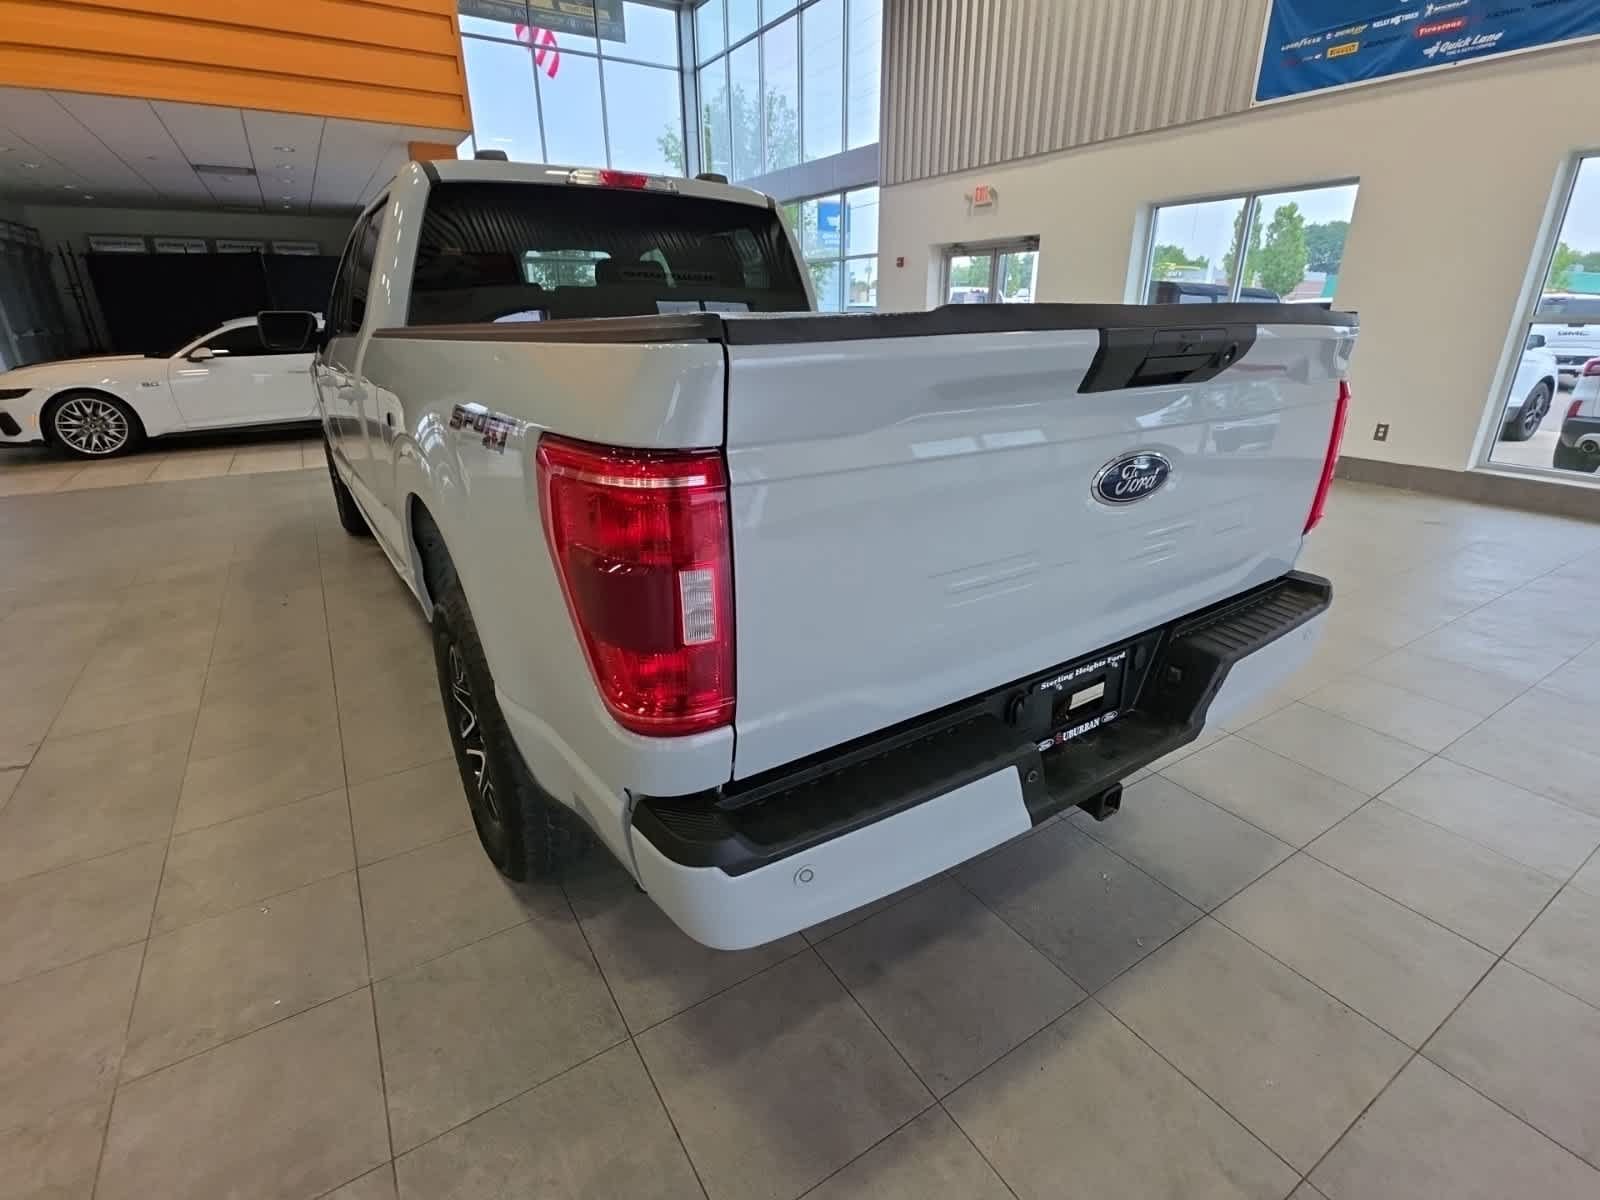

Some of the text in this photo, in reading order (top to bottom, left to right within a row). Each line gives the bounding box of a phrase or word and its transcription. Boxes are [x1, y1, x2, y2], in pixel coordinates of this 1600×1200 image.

[1440, 30, 1504, 53] Quick Lane
[1115, 464, 1161, 495] Ford
[1040, 651, 1126, 690] Sterling Heights Ford
[1055, 717, 1100, 744] SUBURBAN
